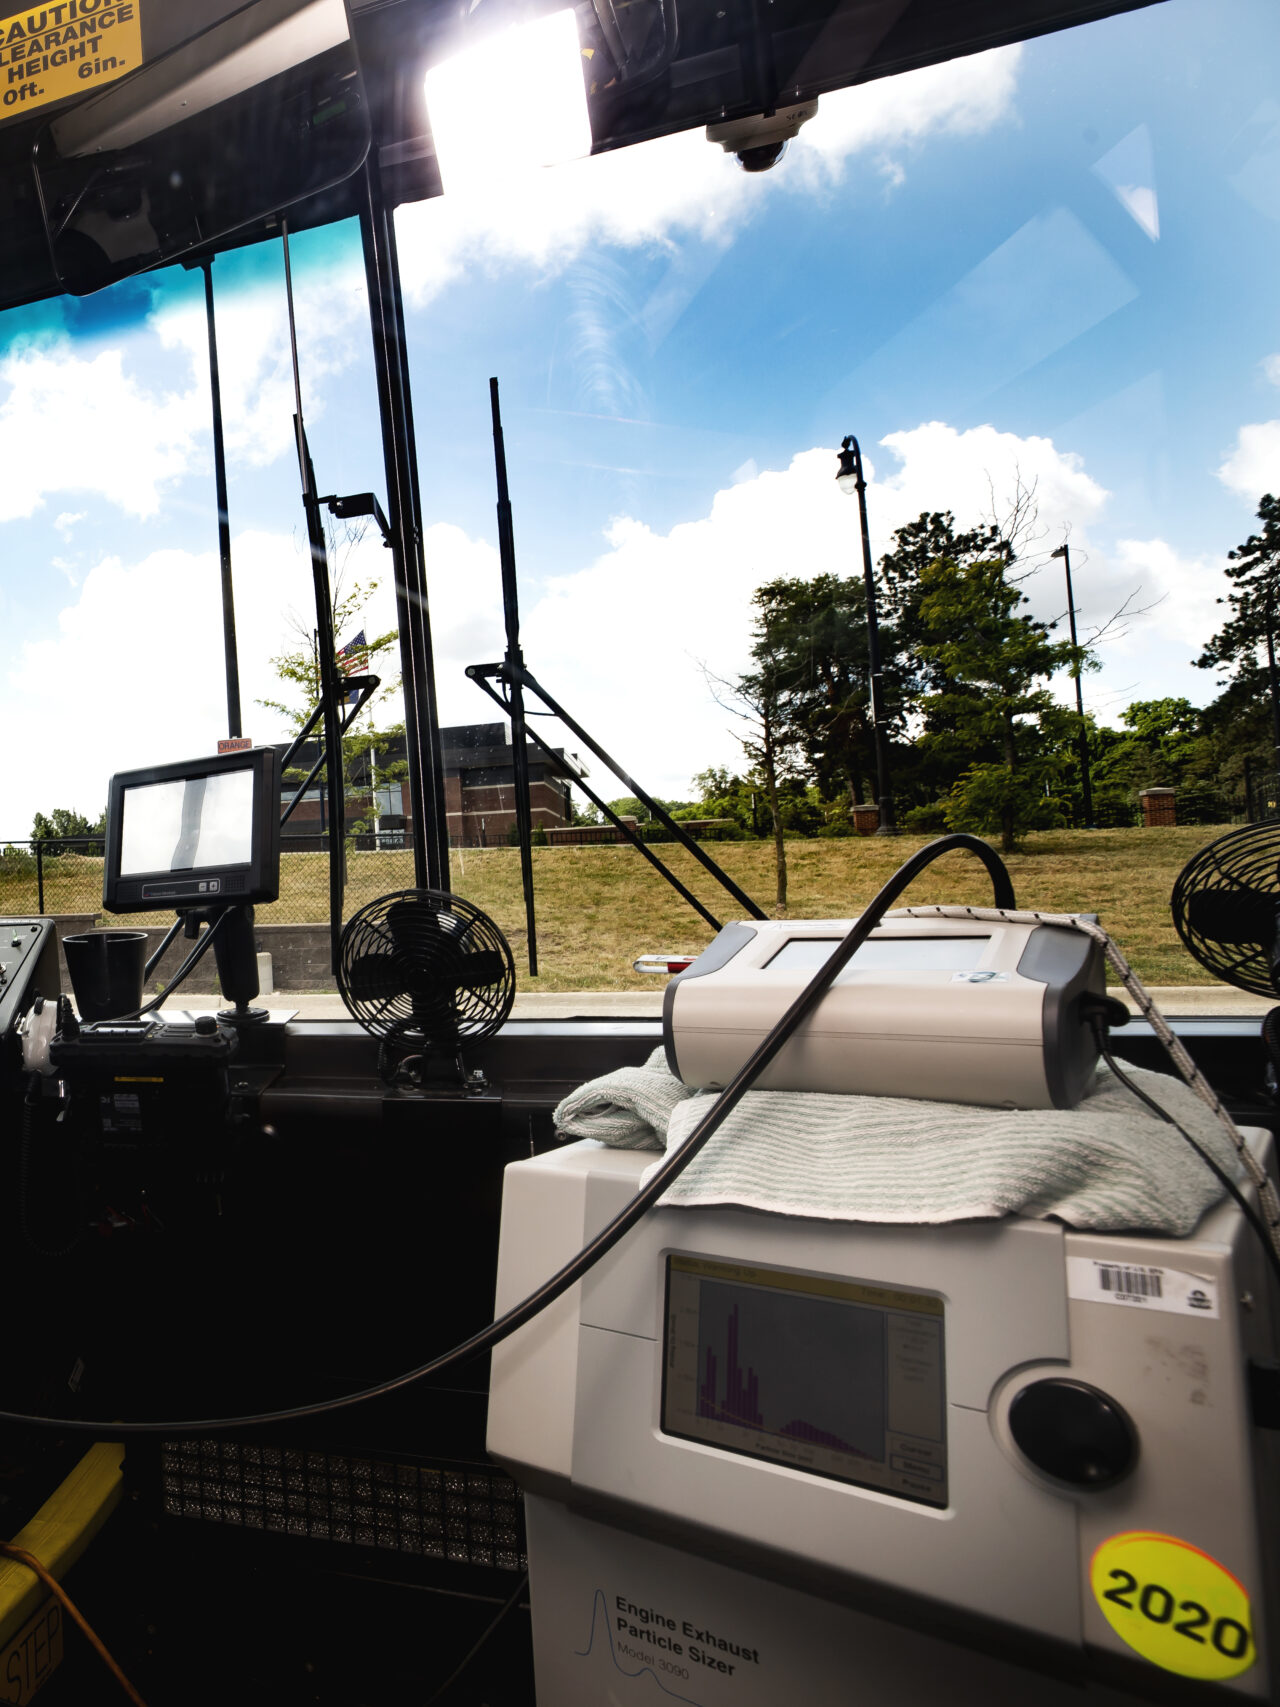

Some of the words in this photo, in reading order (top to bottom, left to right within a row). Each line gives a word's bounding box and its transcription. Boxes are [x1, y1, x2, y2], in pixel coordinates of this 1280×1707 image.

[8, 34, 102, 84] HEIGHT
[77, 55, 126, 79] 6in.
[218, 740, 249, 750] ORANGE
[616, 1596, 677, 1631] Engine
[681, 1621, 760, 1664] Exhaust
[1102, 1568, 1250, 1660] 2020
[6, 1606, 59, 1704] STEP
[616, 1617, 684, 1655] Particle
[688, 1646, 736, 1676] Sizer
[617, 1641, 655, 1666] Model
[658, 1658, 690, 1681] 3090
